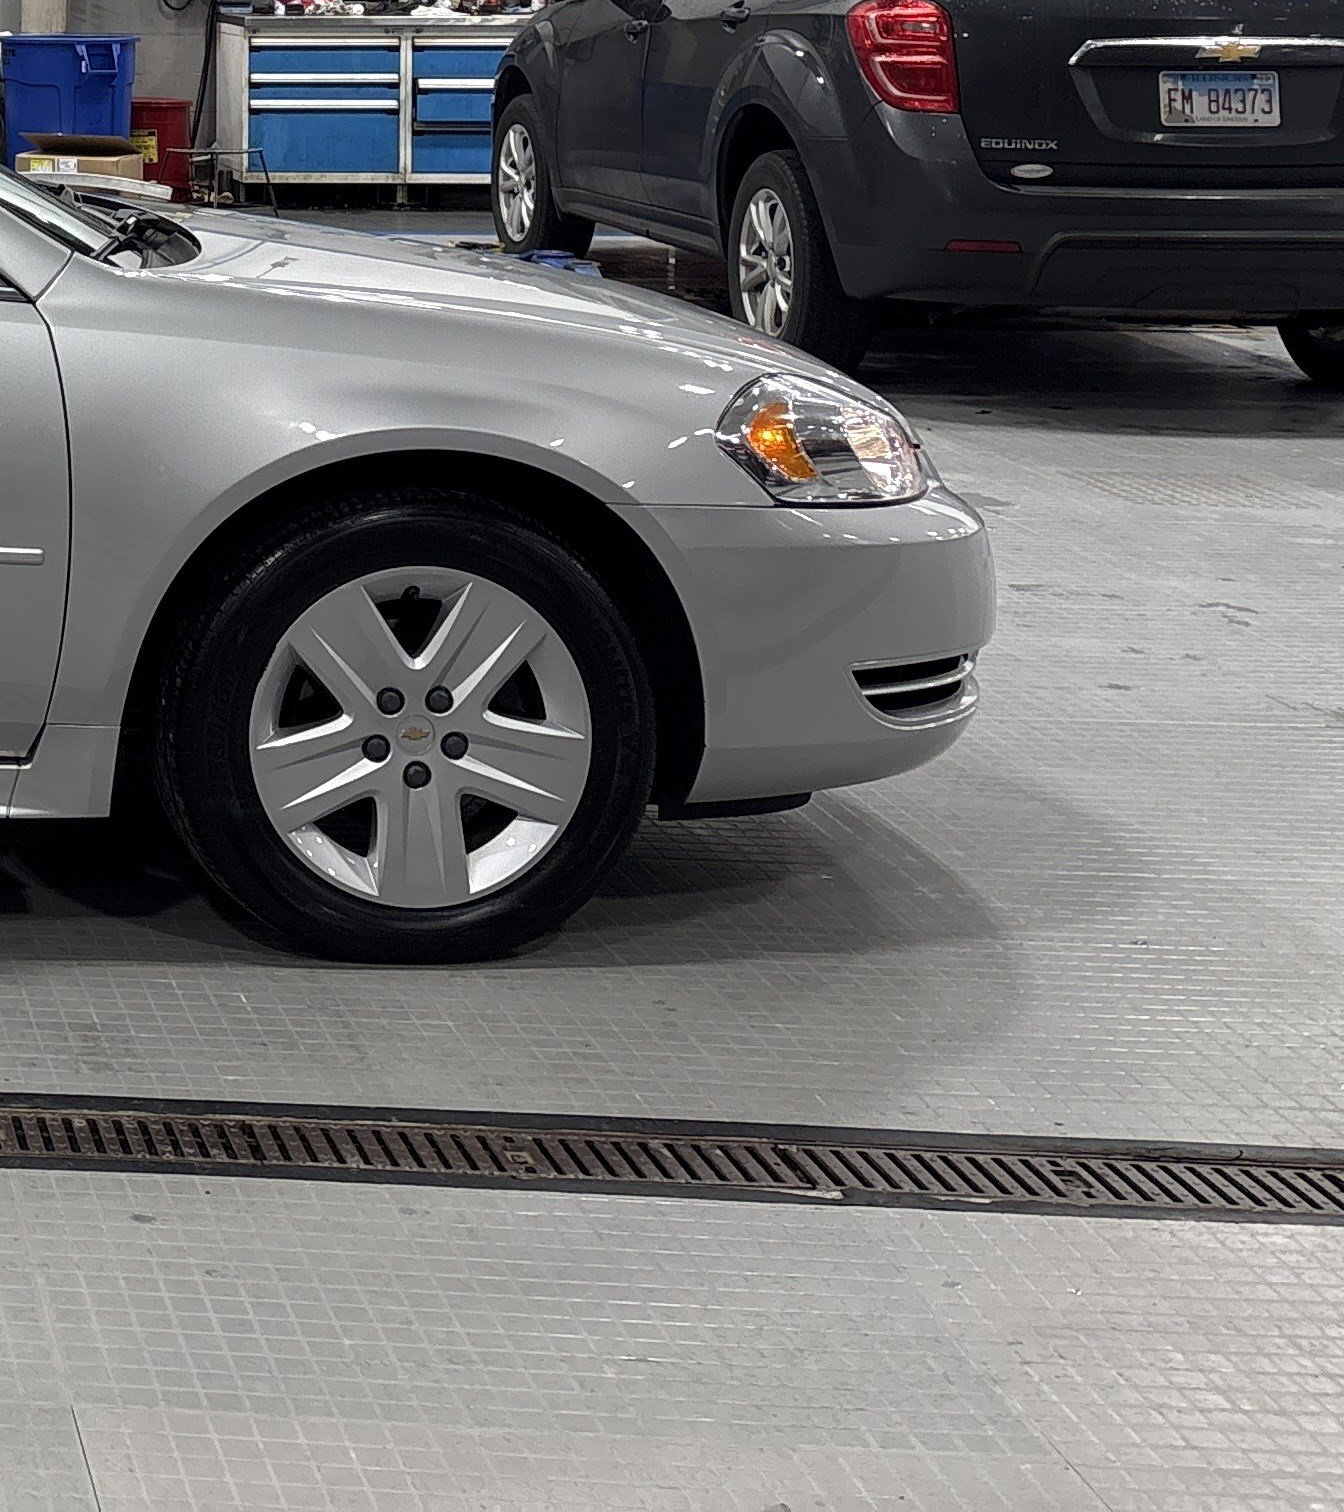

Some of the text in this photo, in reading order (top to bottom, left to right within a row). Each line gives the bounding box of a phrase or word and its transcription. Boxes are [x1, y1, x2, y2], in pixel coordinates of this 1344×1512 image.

[1168, 87, 1274, 115] FM 84373
[980, 137, 1059, 150] EQUINOX
